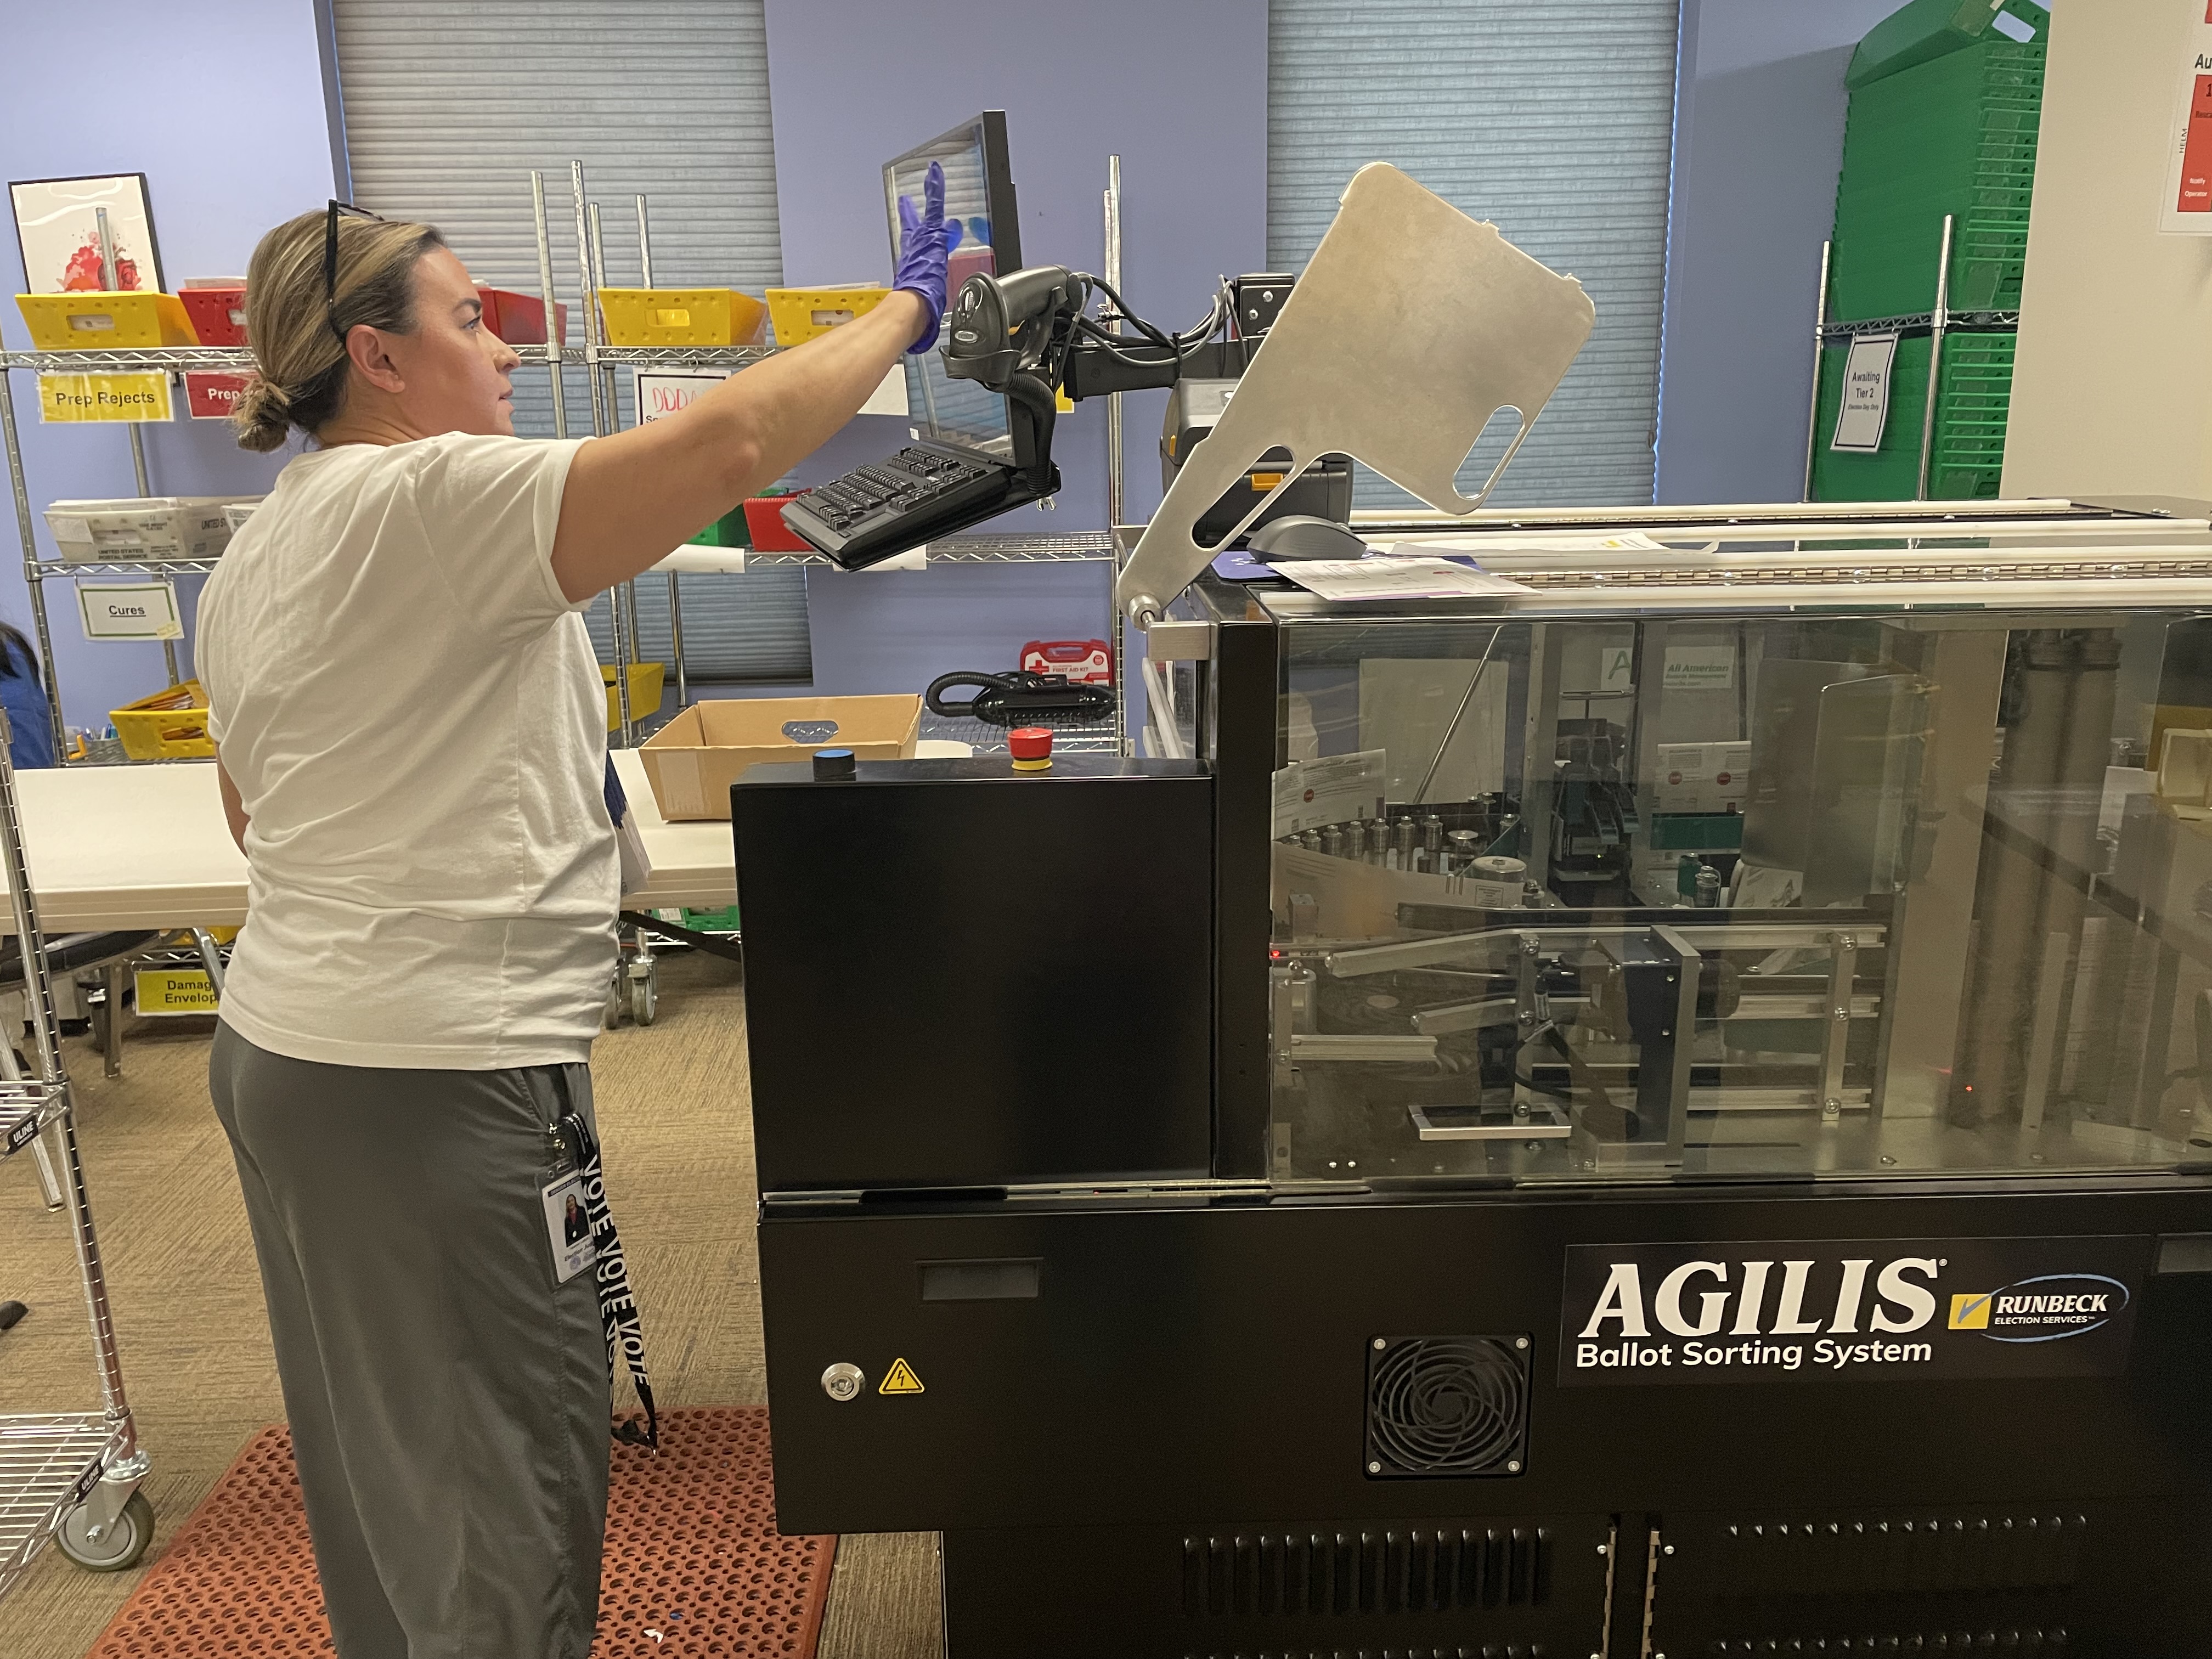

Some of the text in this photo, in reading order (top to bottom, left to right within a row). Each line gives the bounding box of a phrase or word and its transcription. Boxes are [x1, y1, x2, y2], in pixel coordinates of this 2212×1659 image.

[2179, 128, 2188, 154] HELM
[1852, 370, 1880, 384] Awaiting
[55, 391, 155, 408] Prep Rejects
[207, 388, 240, 401] Prep
[1857, 387, 1874, 398] Tier 2
[202, 518, 219, 531] UNITED
[109, 605, 145, 615] Cures
[1607, 650, 1631, 680] A
[1668, 664, 1729, 672] All American
[167, 980, 212, 991] Damag
[165, 992, 217, 1005] Envelop
[13, 1121, 33, 1143] ULINE
[584, 1153, 615, 1236] VOTE
[601, 1235, 635, 1312] VOTE
[618, 1317, 650, 1386] VOTE
[1577, 1257, 1938, 1338] AGILIS
[1995, 1294, 2109, 1314] RUNBECK
[1994, 1316, 2088, 1325] ELECTION SERVICES
[1576, 1339, 1932, 1370] Ballot Sorting System
